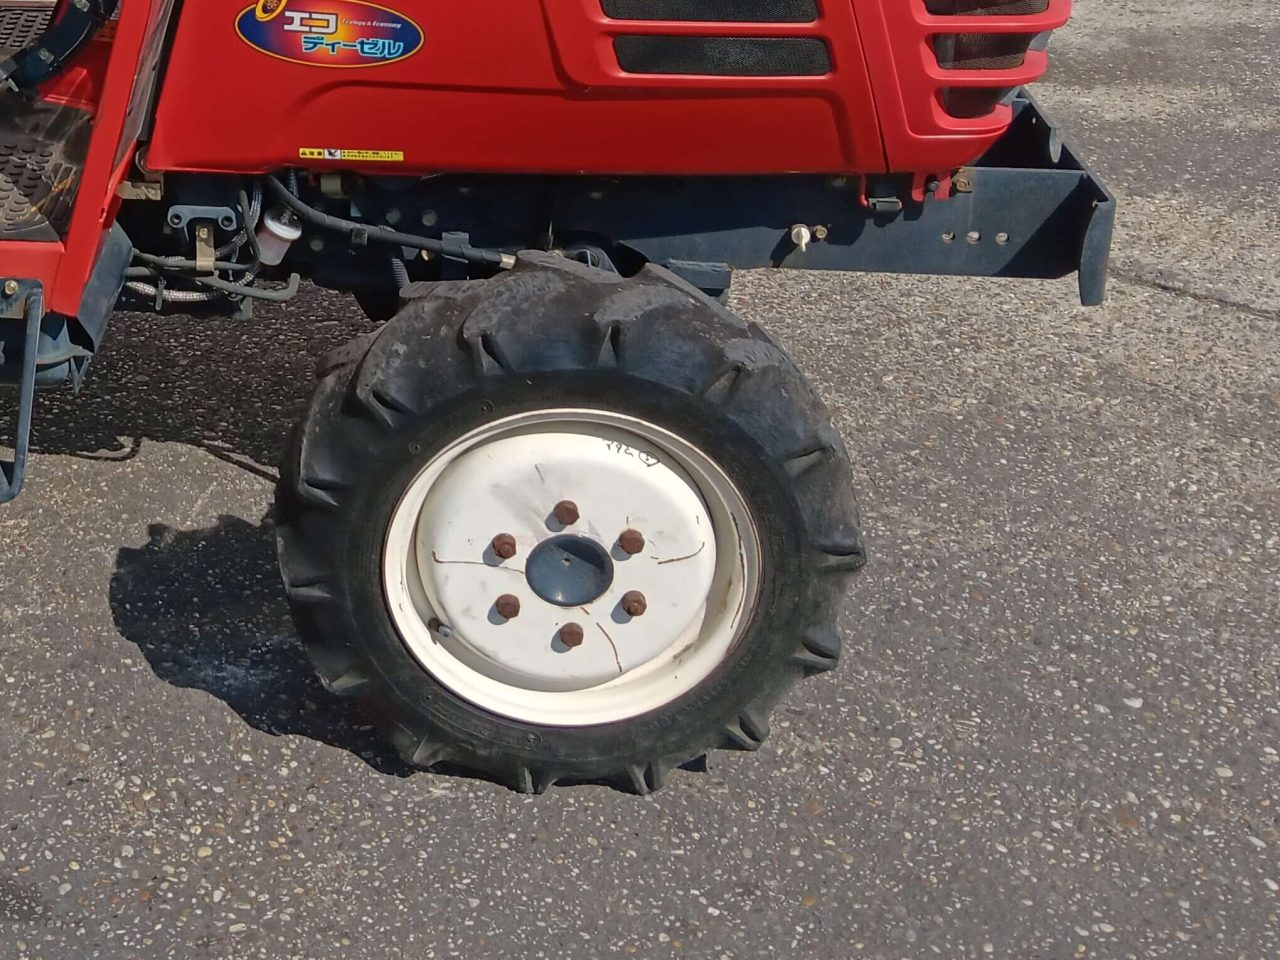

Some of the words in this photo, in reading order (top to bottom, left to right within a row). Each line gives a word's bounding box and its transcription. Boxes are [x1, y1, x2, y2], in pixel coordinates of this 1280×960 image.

[283, 10, 338, 34] エコ
[303, 36, 404, 57] ディーゼル
